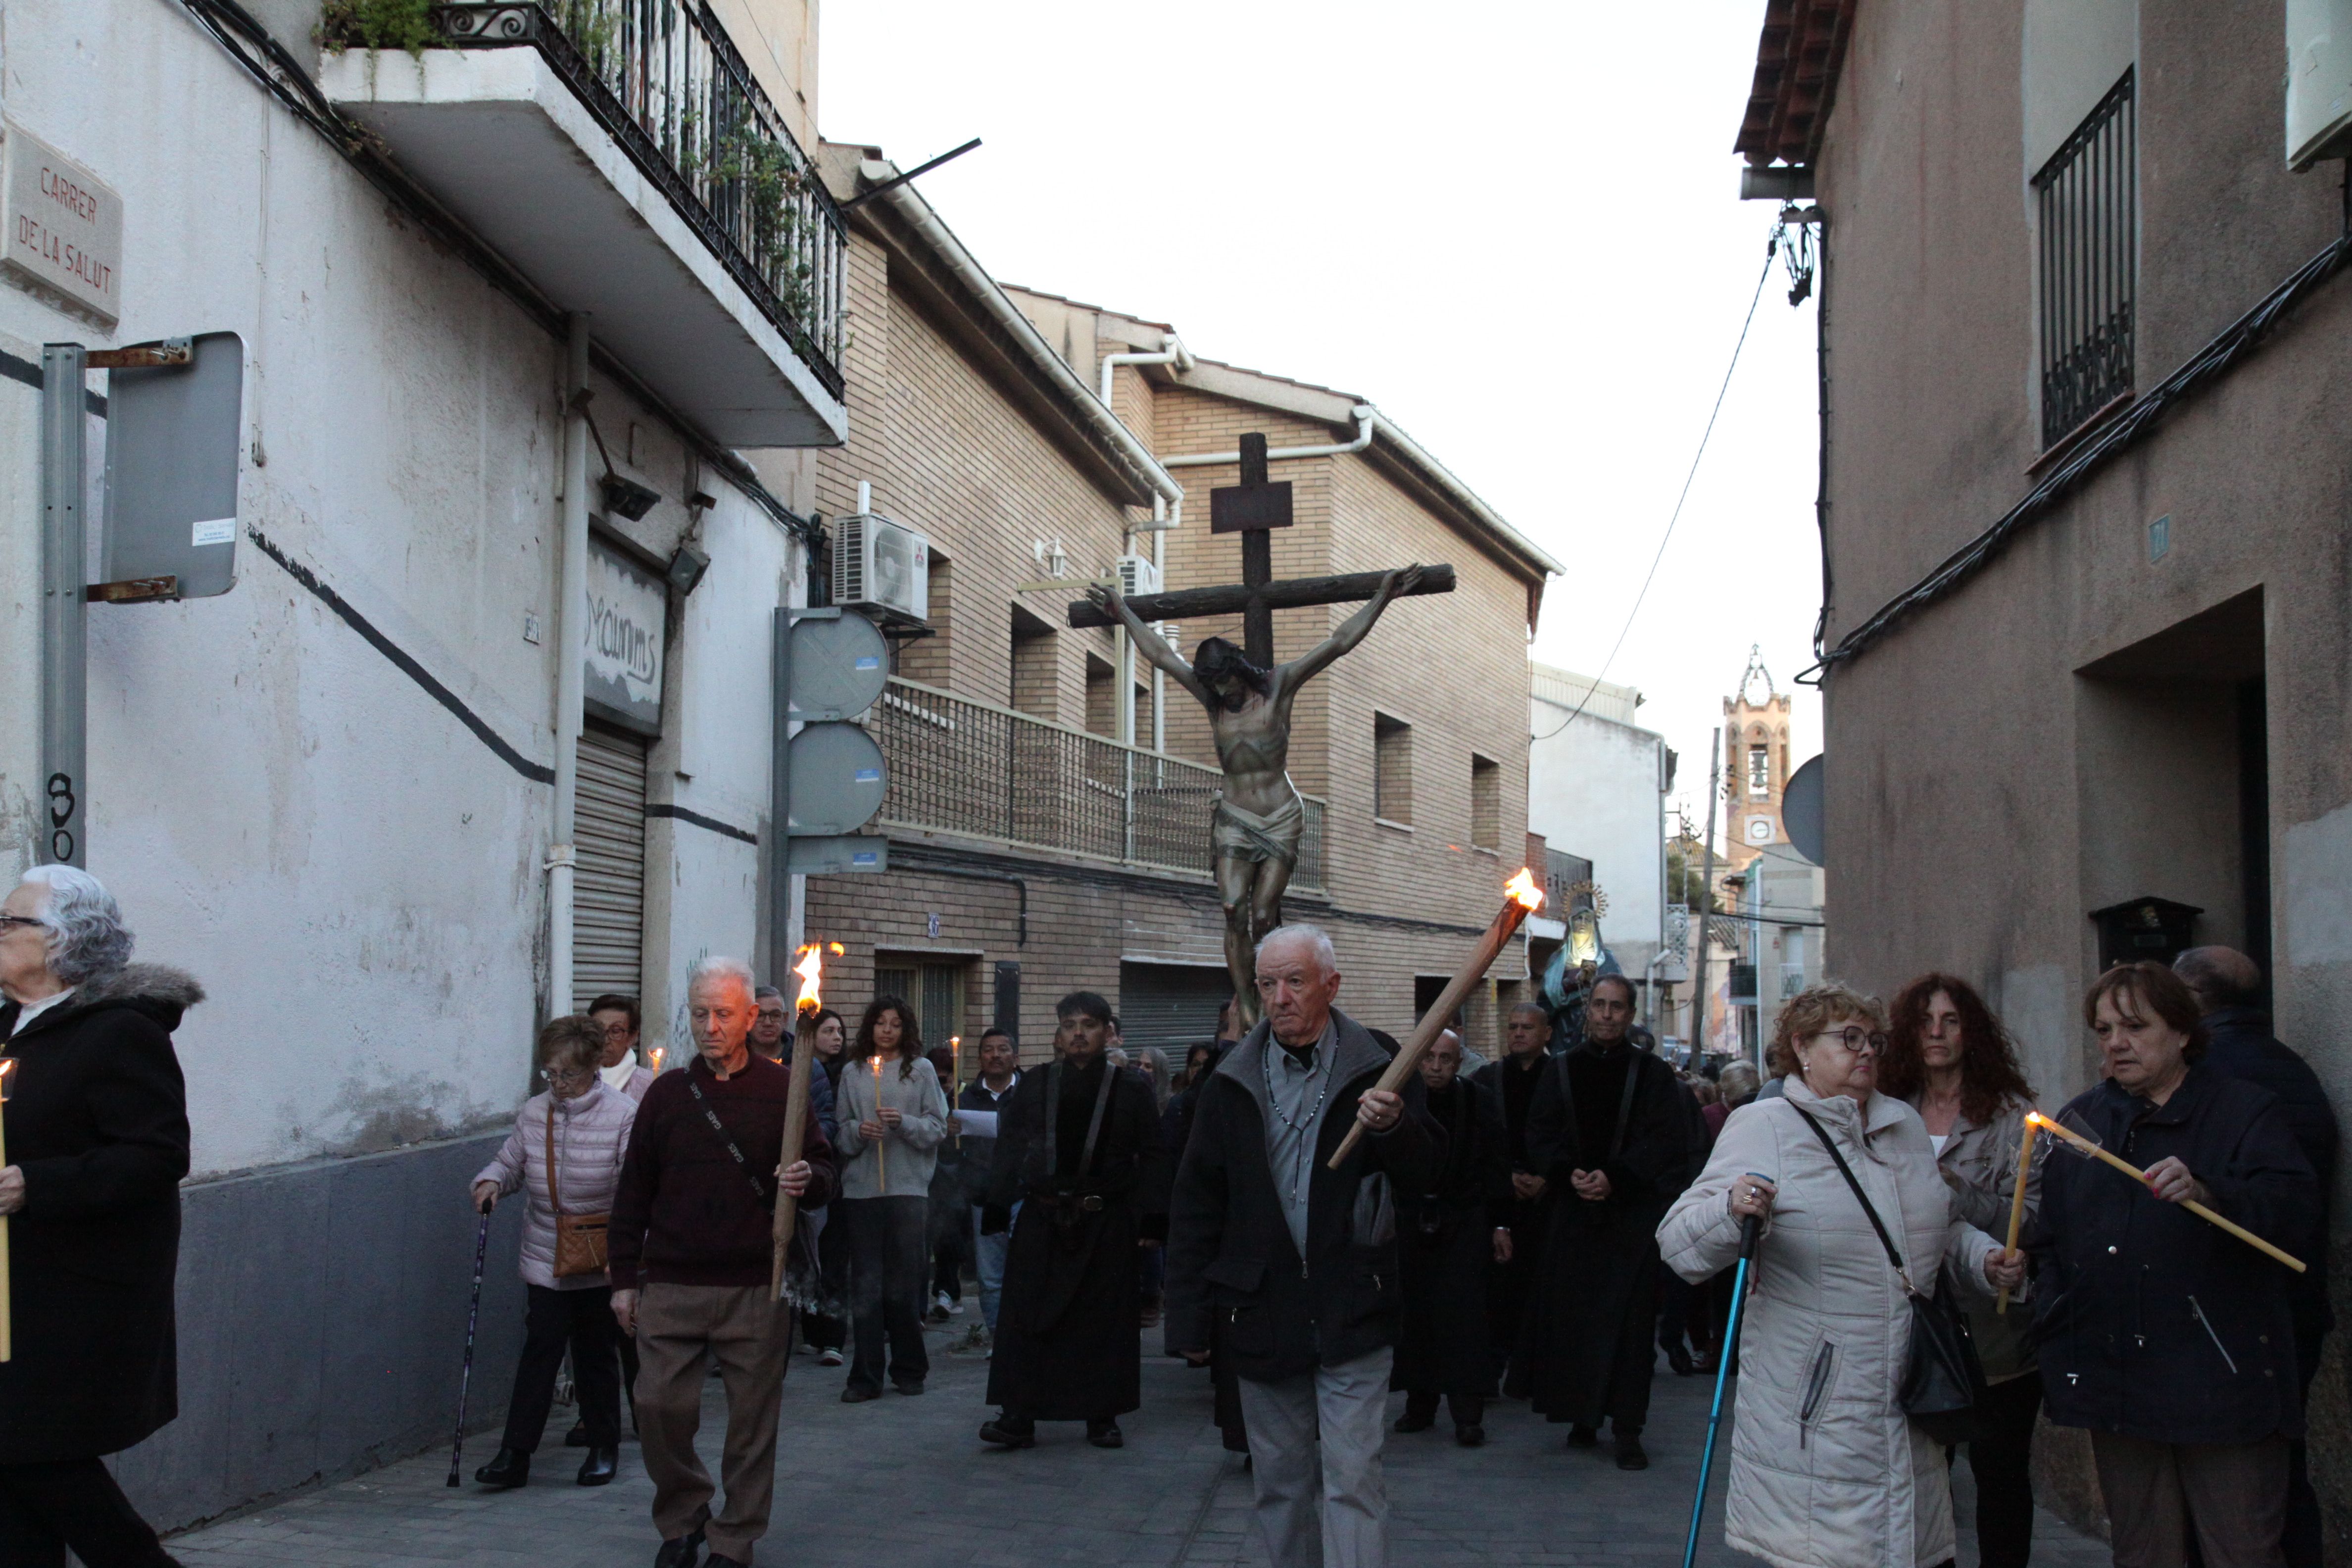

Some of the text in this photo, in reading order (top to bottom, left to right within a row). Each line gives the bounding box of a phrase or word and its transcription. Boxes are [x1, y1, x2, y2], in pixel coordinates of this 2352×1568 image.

[41, 167, 97, 225] CARRER
[19, 214, 111, 294] DE LA SALUT
[706, 1110, 722, 1129] GAES
[728, 1143, 744, 1163] GAES
